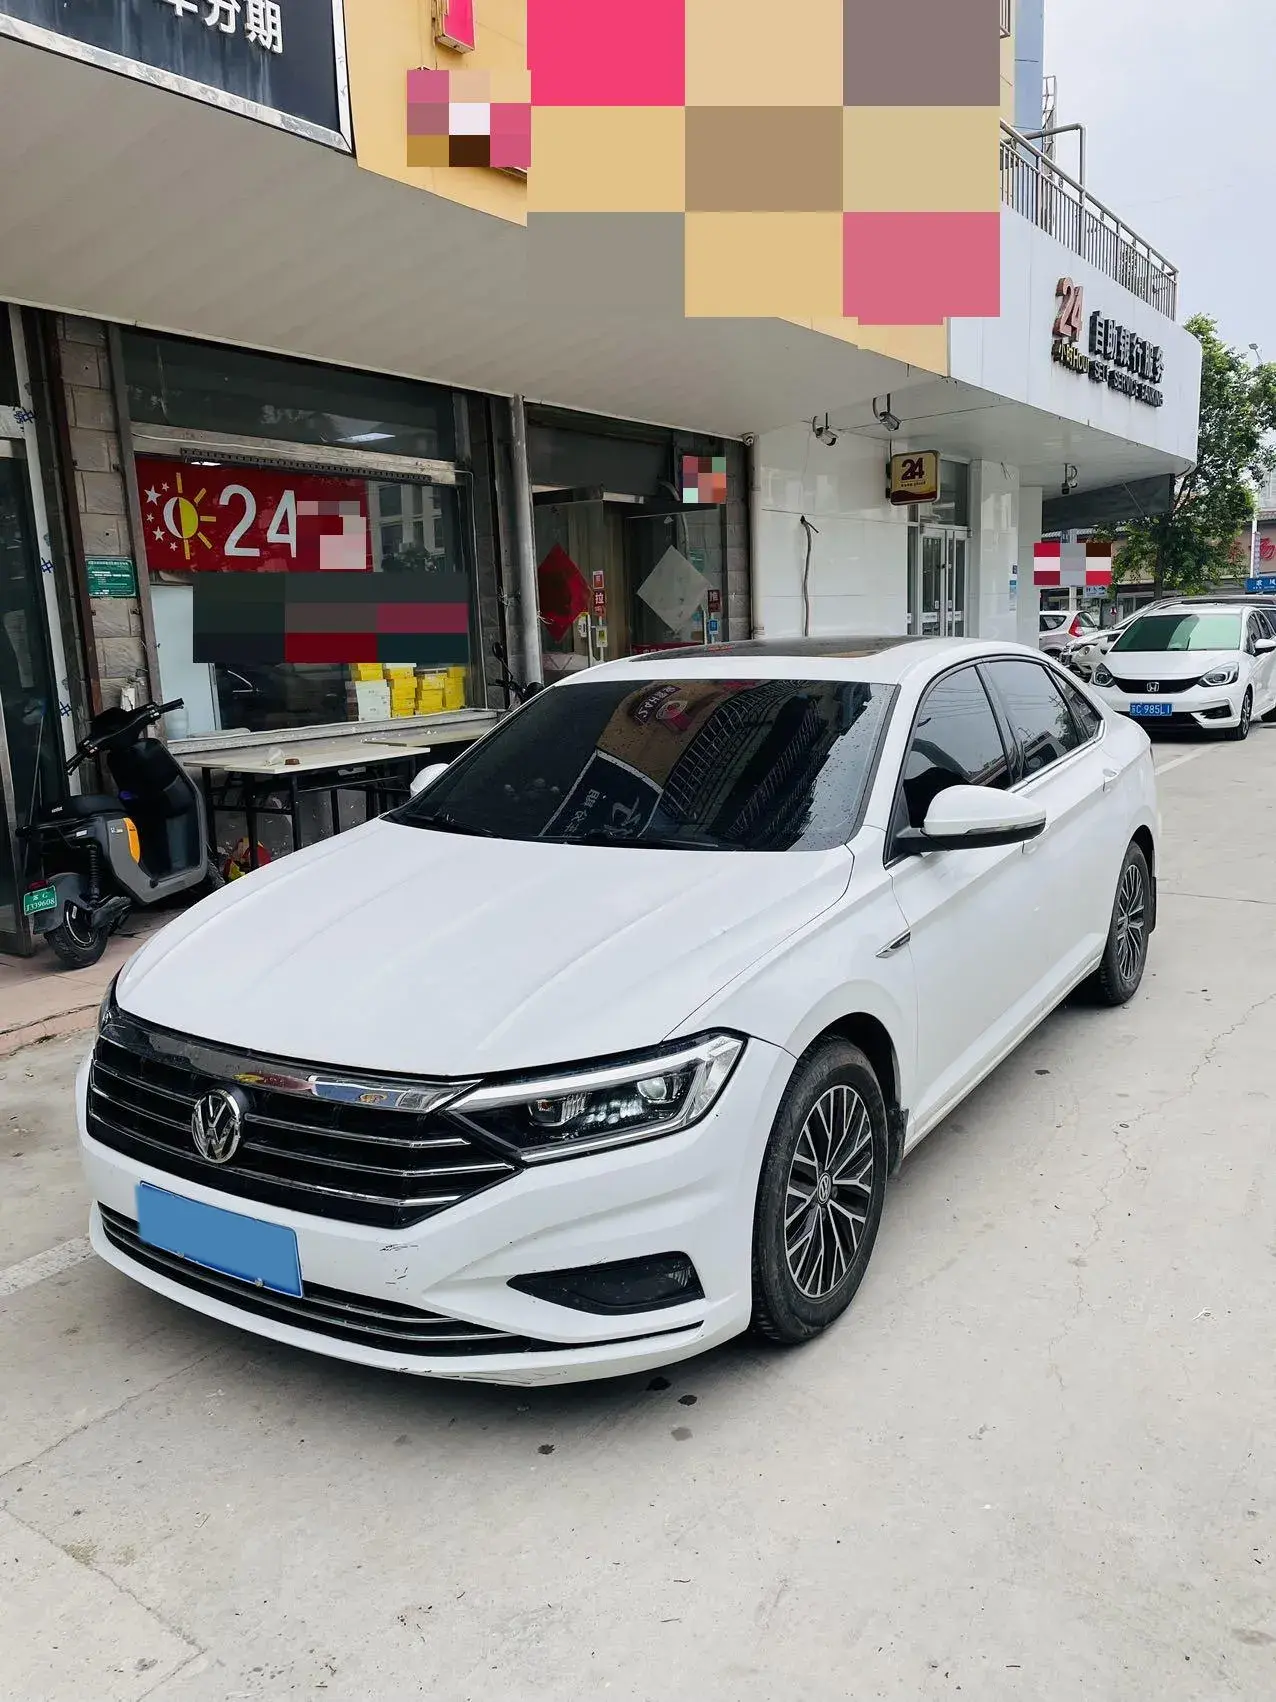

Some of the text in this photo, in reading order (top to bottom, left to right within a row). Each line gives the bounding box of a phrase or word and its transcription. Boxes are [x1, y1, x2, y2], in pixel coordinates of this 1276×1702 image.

[1052, 277, 1083, 341] 24
[1089, 310, 1163, 383] 自助银行服务
[901, 457, 924, 480] 24
[219, 484, 297, 558] 24
